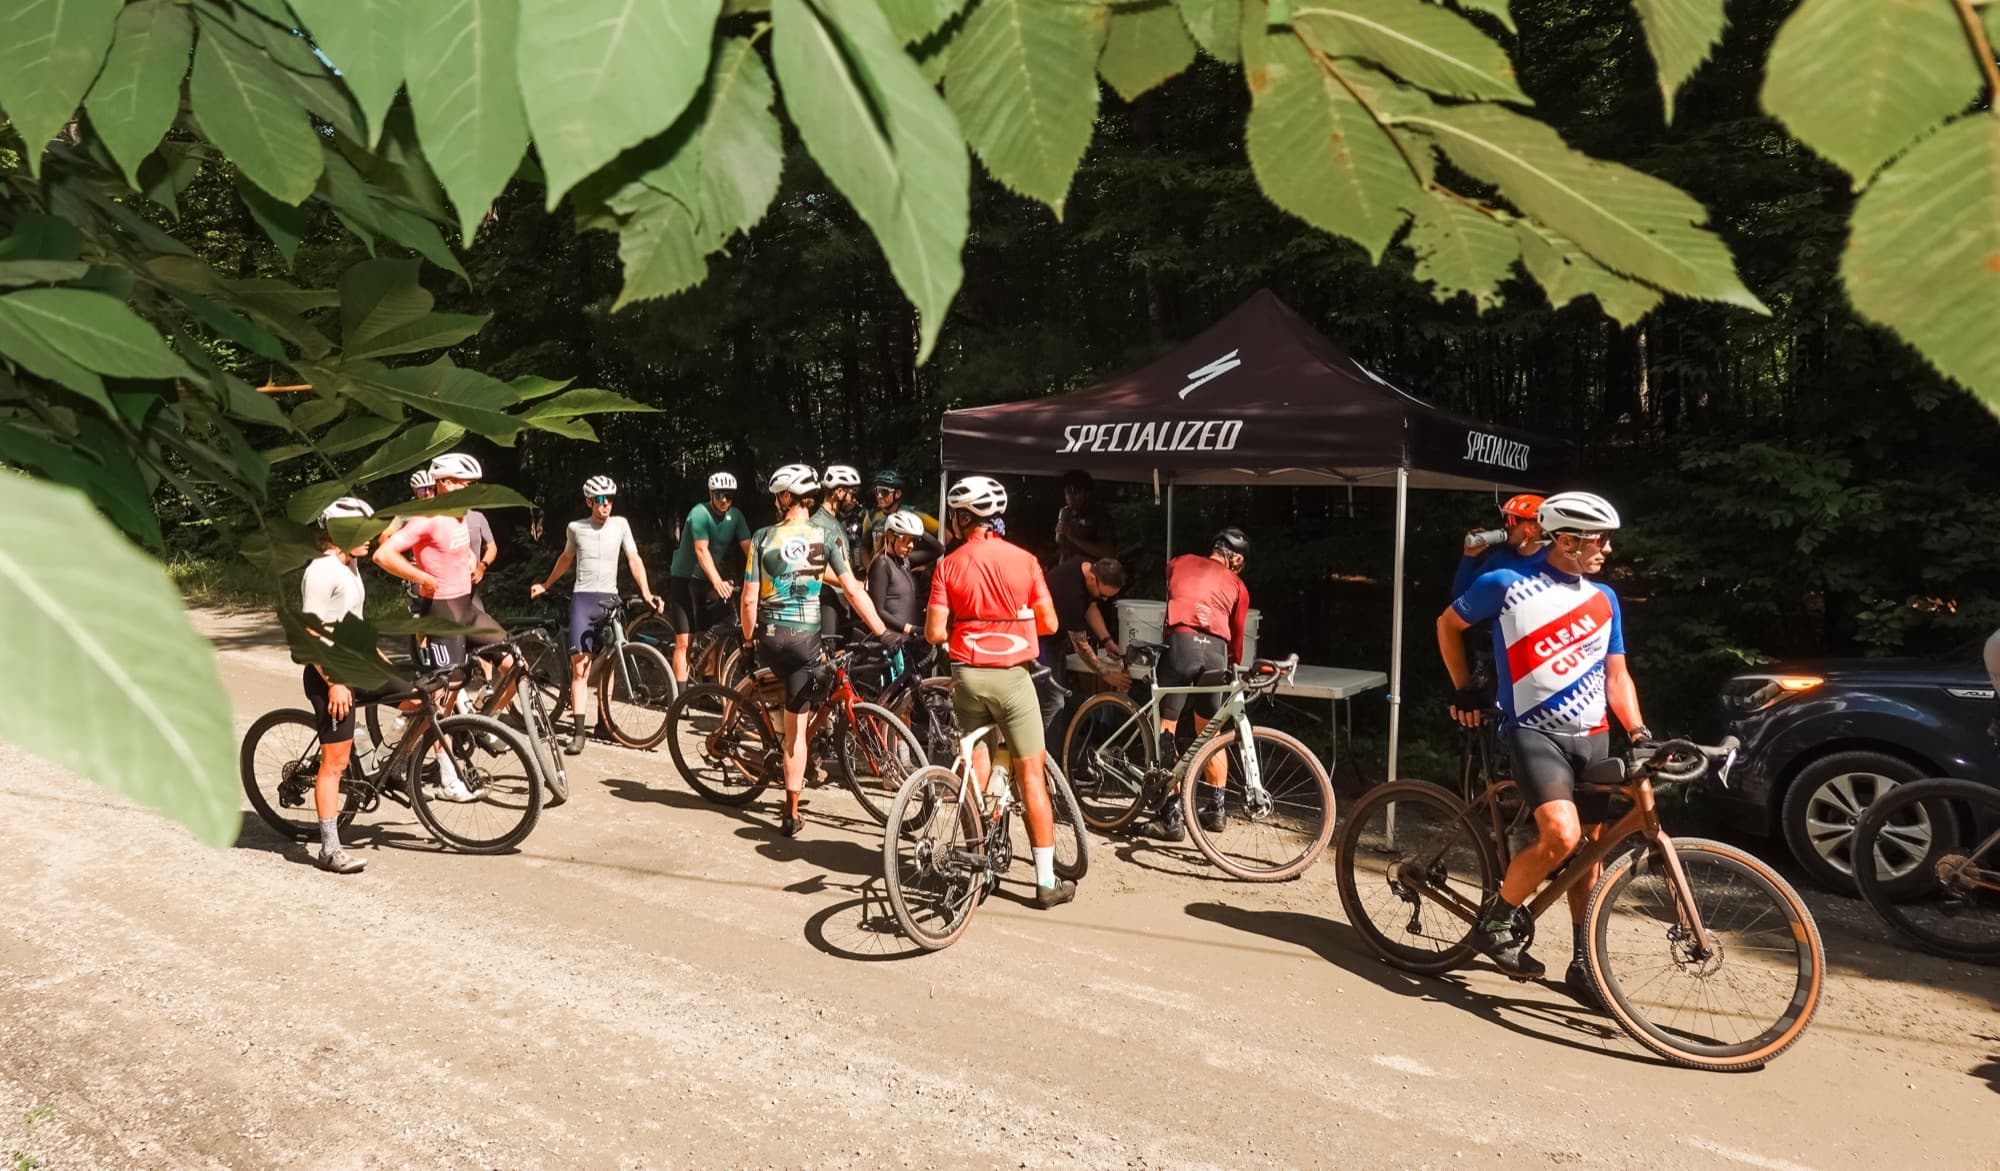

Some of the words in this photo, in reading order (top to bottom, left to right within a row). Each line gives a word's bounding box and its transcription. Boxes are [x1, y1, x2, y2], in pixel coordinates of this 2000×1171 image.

[1056, 420, 1243, 453] SPECIALIZED
[1463, 430, 1530, 471] SPECIALIZED
[1535, 614, 1597, 657] CLEAN
[1551, 646, 1585, 676] CUT
